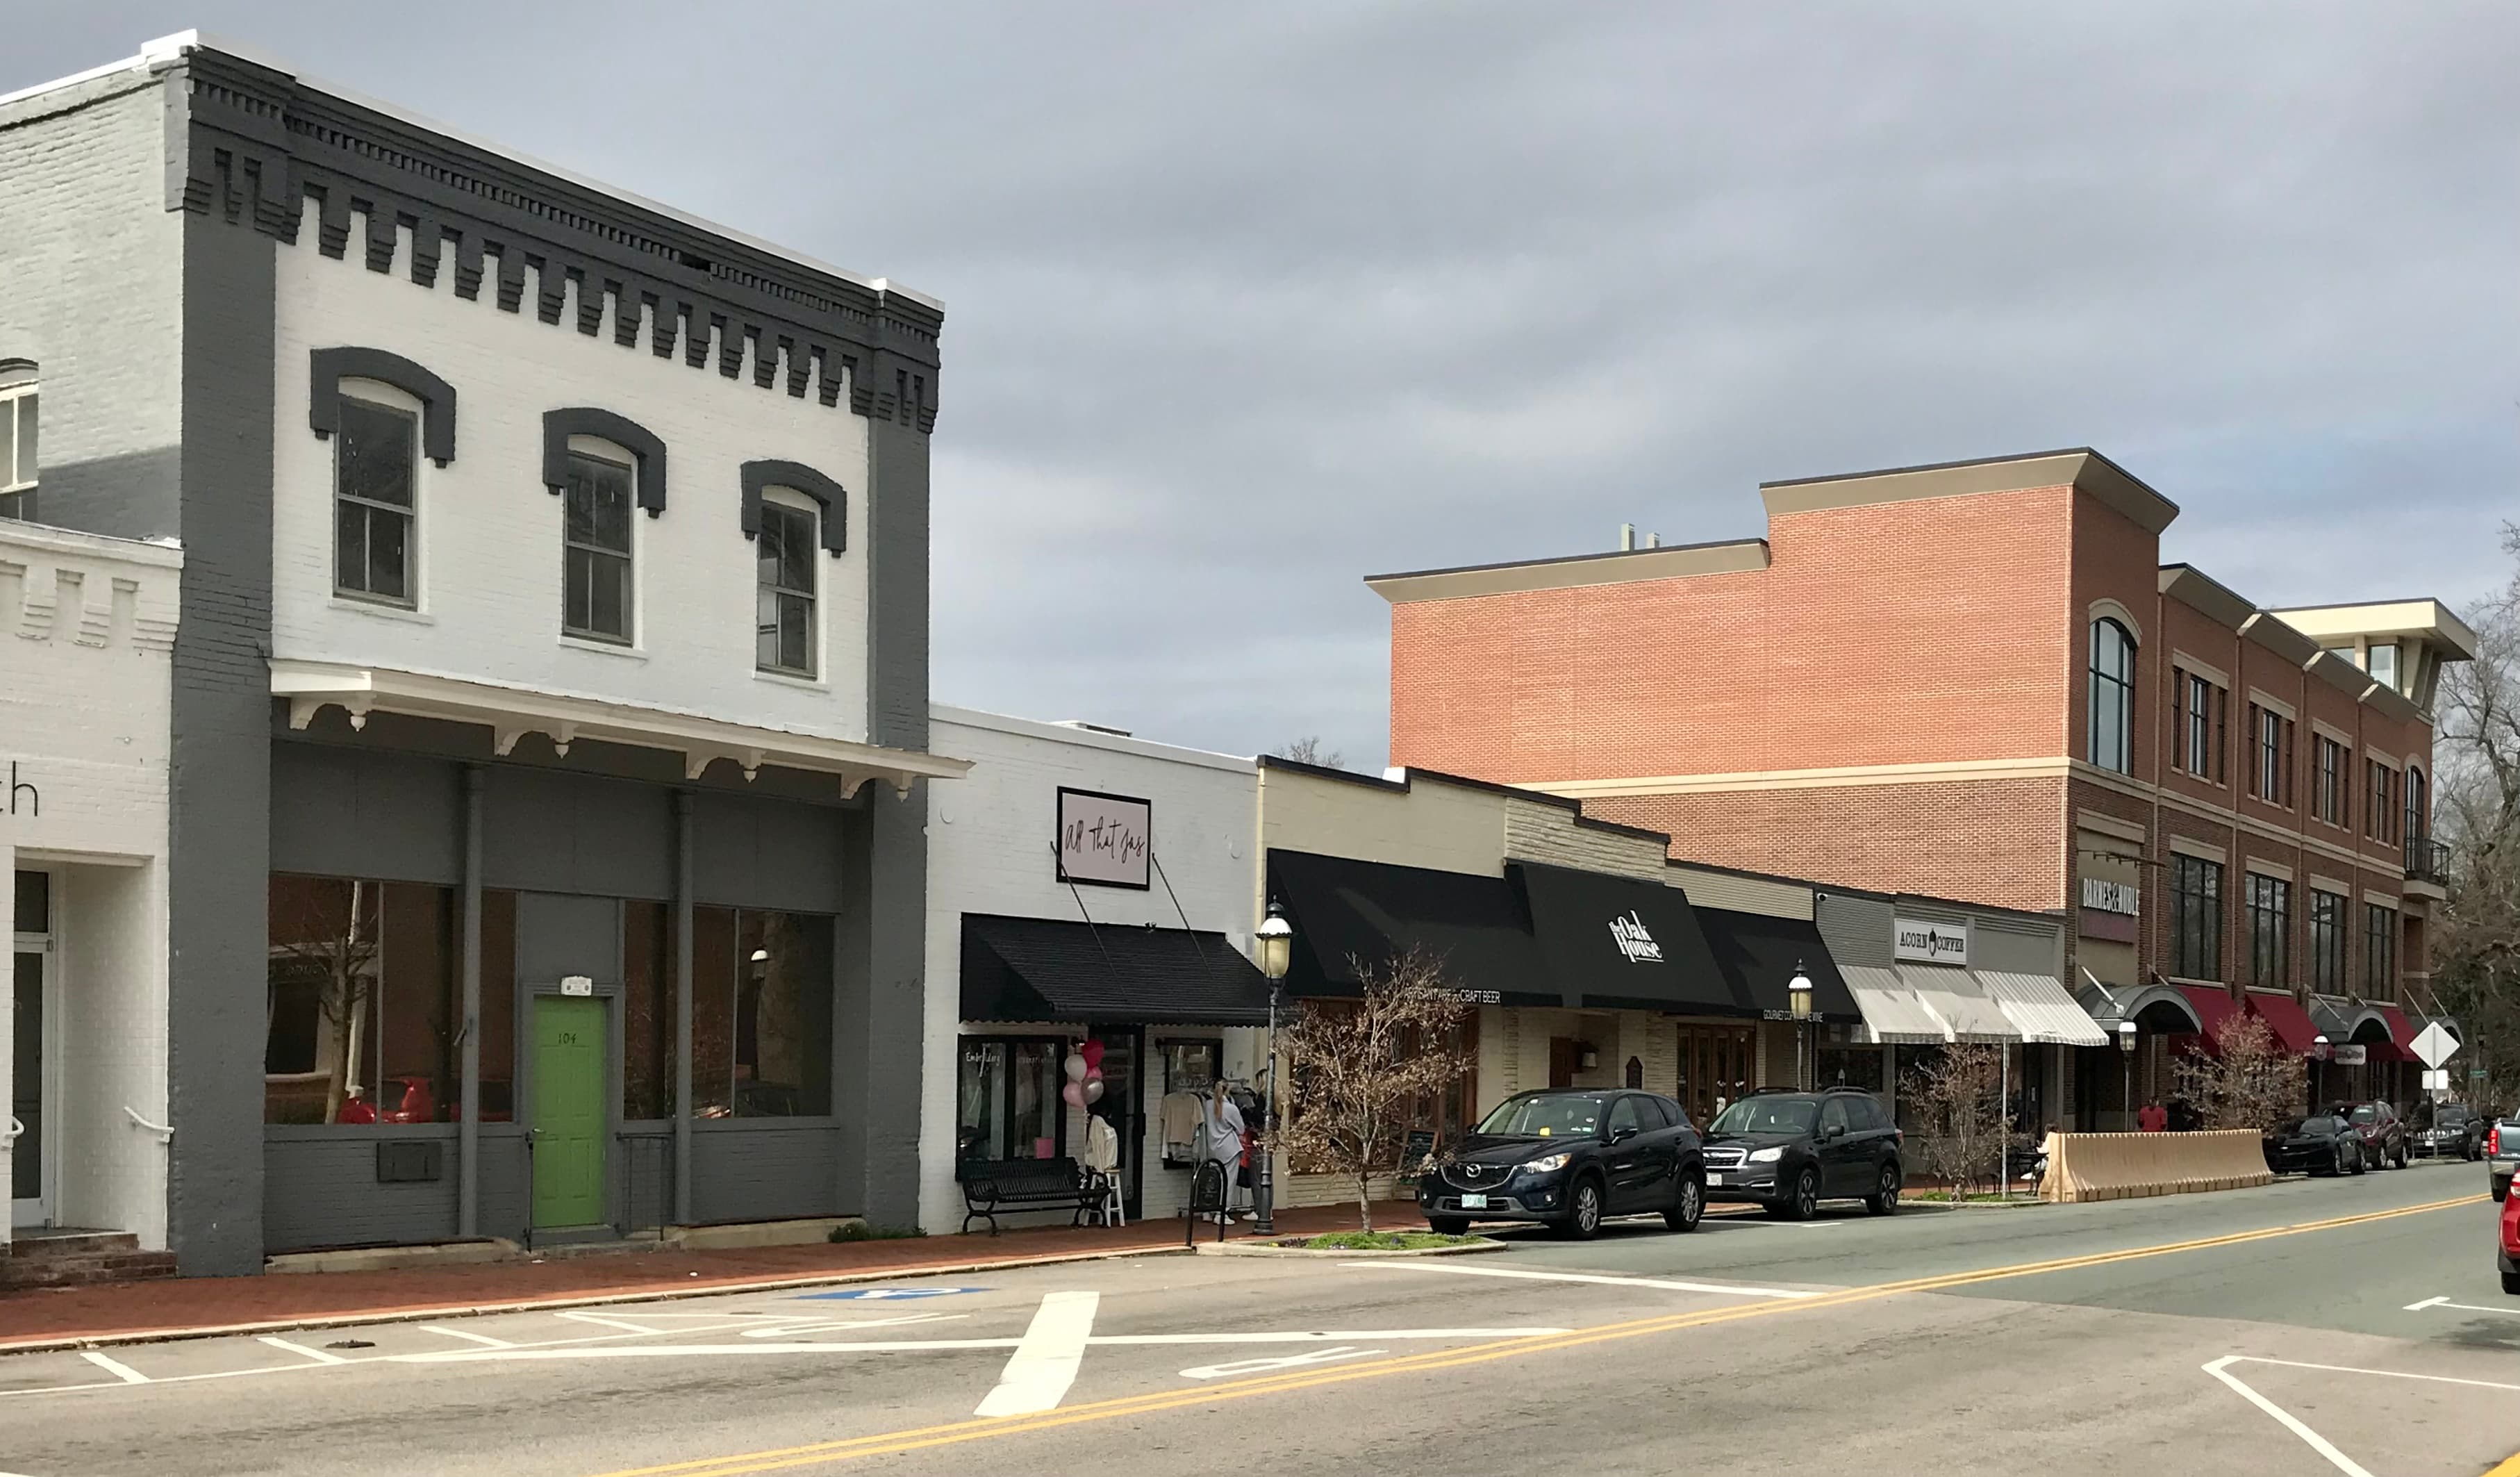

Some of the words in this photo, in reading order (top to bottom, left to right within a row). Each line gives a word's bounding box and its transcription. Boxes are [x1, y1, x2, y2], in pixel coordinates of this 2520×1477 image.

[1617, 909, 1653, 941] Oak
[1613, 932, 1663, 963] House
[1899, 931, 1928, 949] ACORN
[1937, 935, 1964, 952] COFFEE
[1459, 989, 1482, 1003] CRAFT
[1482, 990, 1501, 1004] BEER
[558, 1033, 577, 1044] 104
